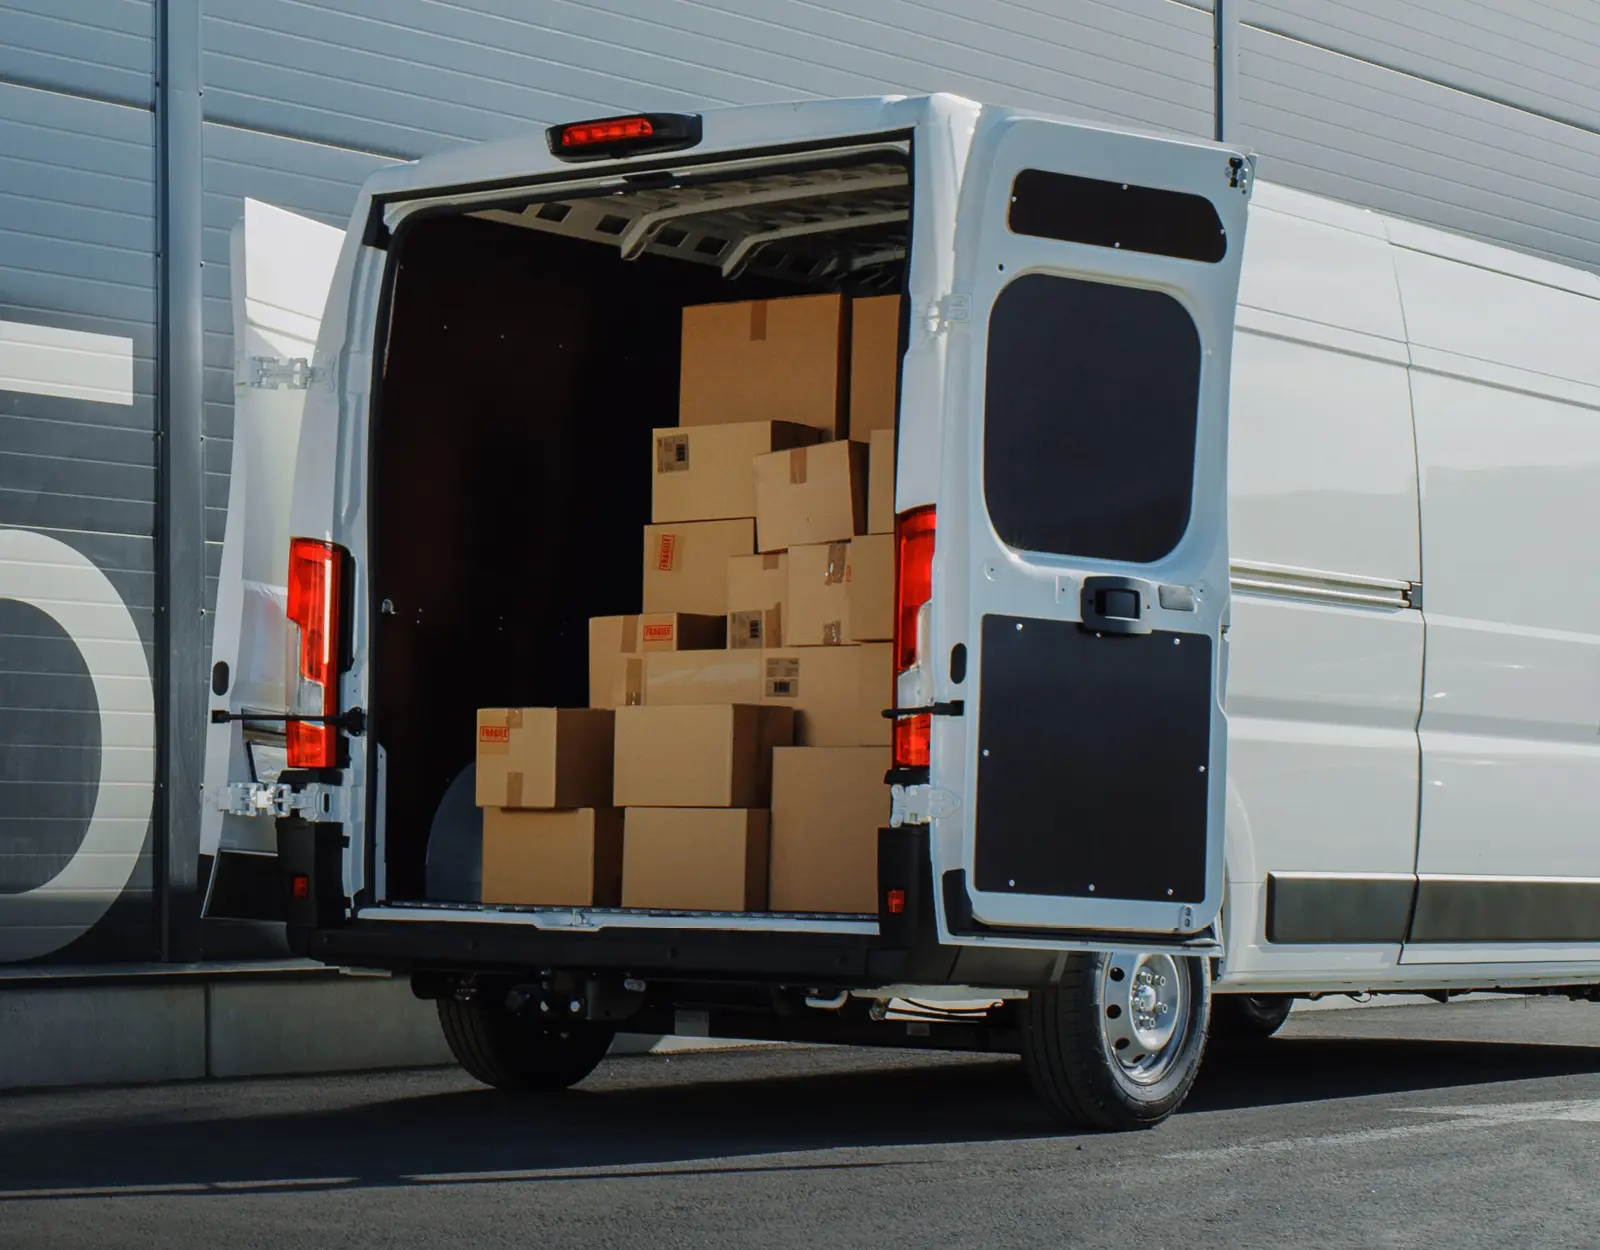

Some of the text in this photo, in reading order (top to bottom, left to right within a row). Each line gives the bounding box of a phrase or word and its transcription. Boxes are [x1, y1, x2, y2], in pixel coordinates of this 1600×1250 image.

[661, 537, 671, 568] FRAGILE
[645, 626, 671, 637] FRAGILE
[481, 727, 507, 738] FRAGILE
